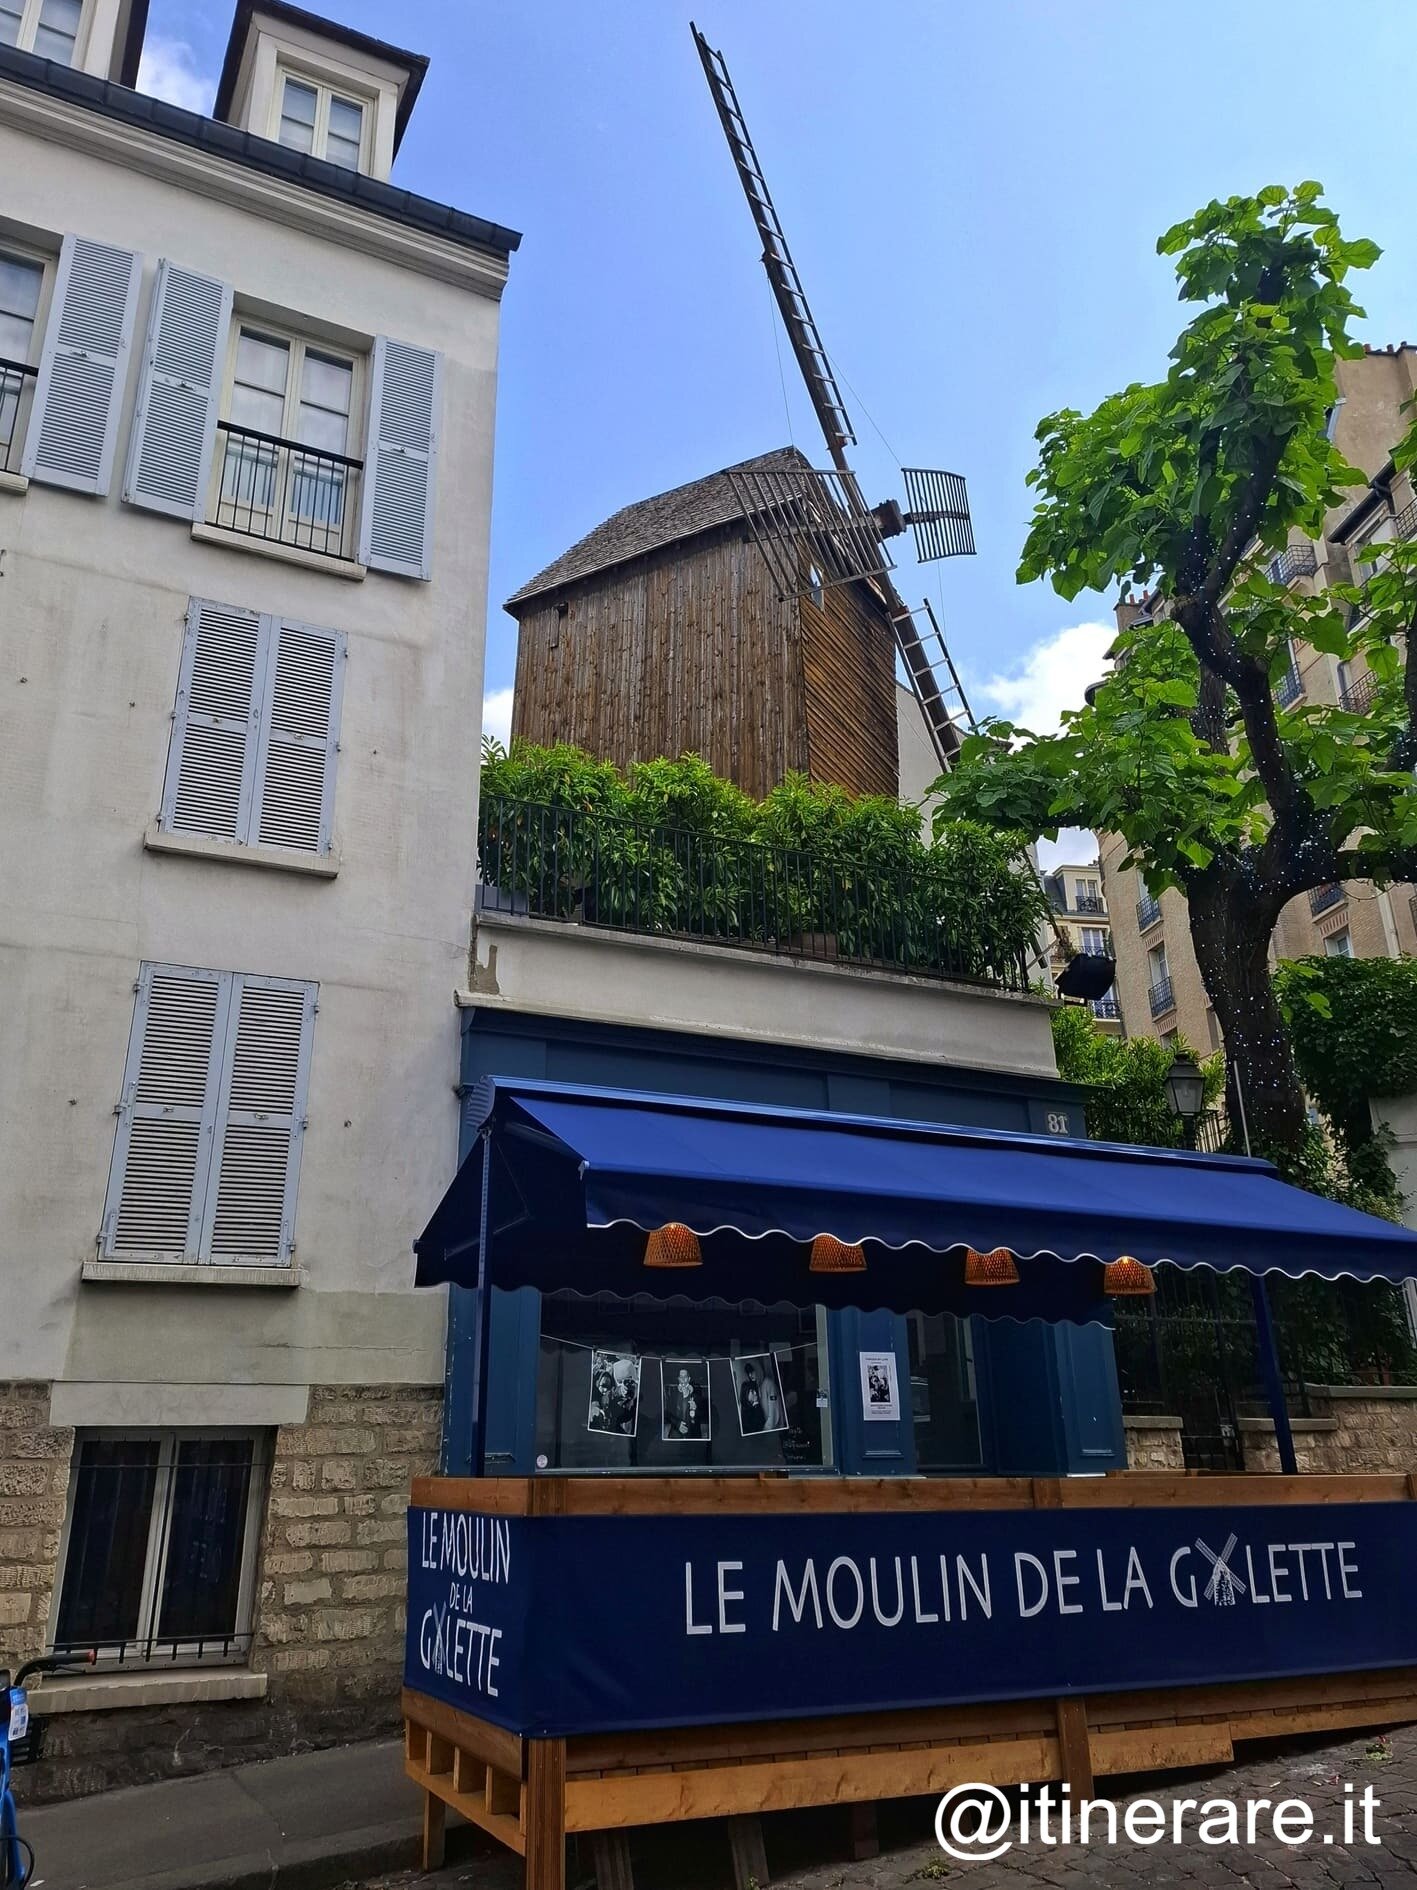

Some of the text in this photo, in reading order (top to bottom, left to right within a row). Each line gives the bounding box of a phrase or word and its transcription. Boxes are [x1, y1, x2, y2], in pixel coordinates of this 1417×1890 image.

[1047, 1113, 1068, 1134] 81
[421, 1511, 510, 1584] LE MOULIN
[449, 1582, 473, 1614] DE LA
[685, 1561, 746, 1635] LE
[772, 1553, 992, 1632] MOULIN
[1014, 1550, 1084, 1618] DE
[1096, 1546, 1154, 1611] LA
